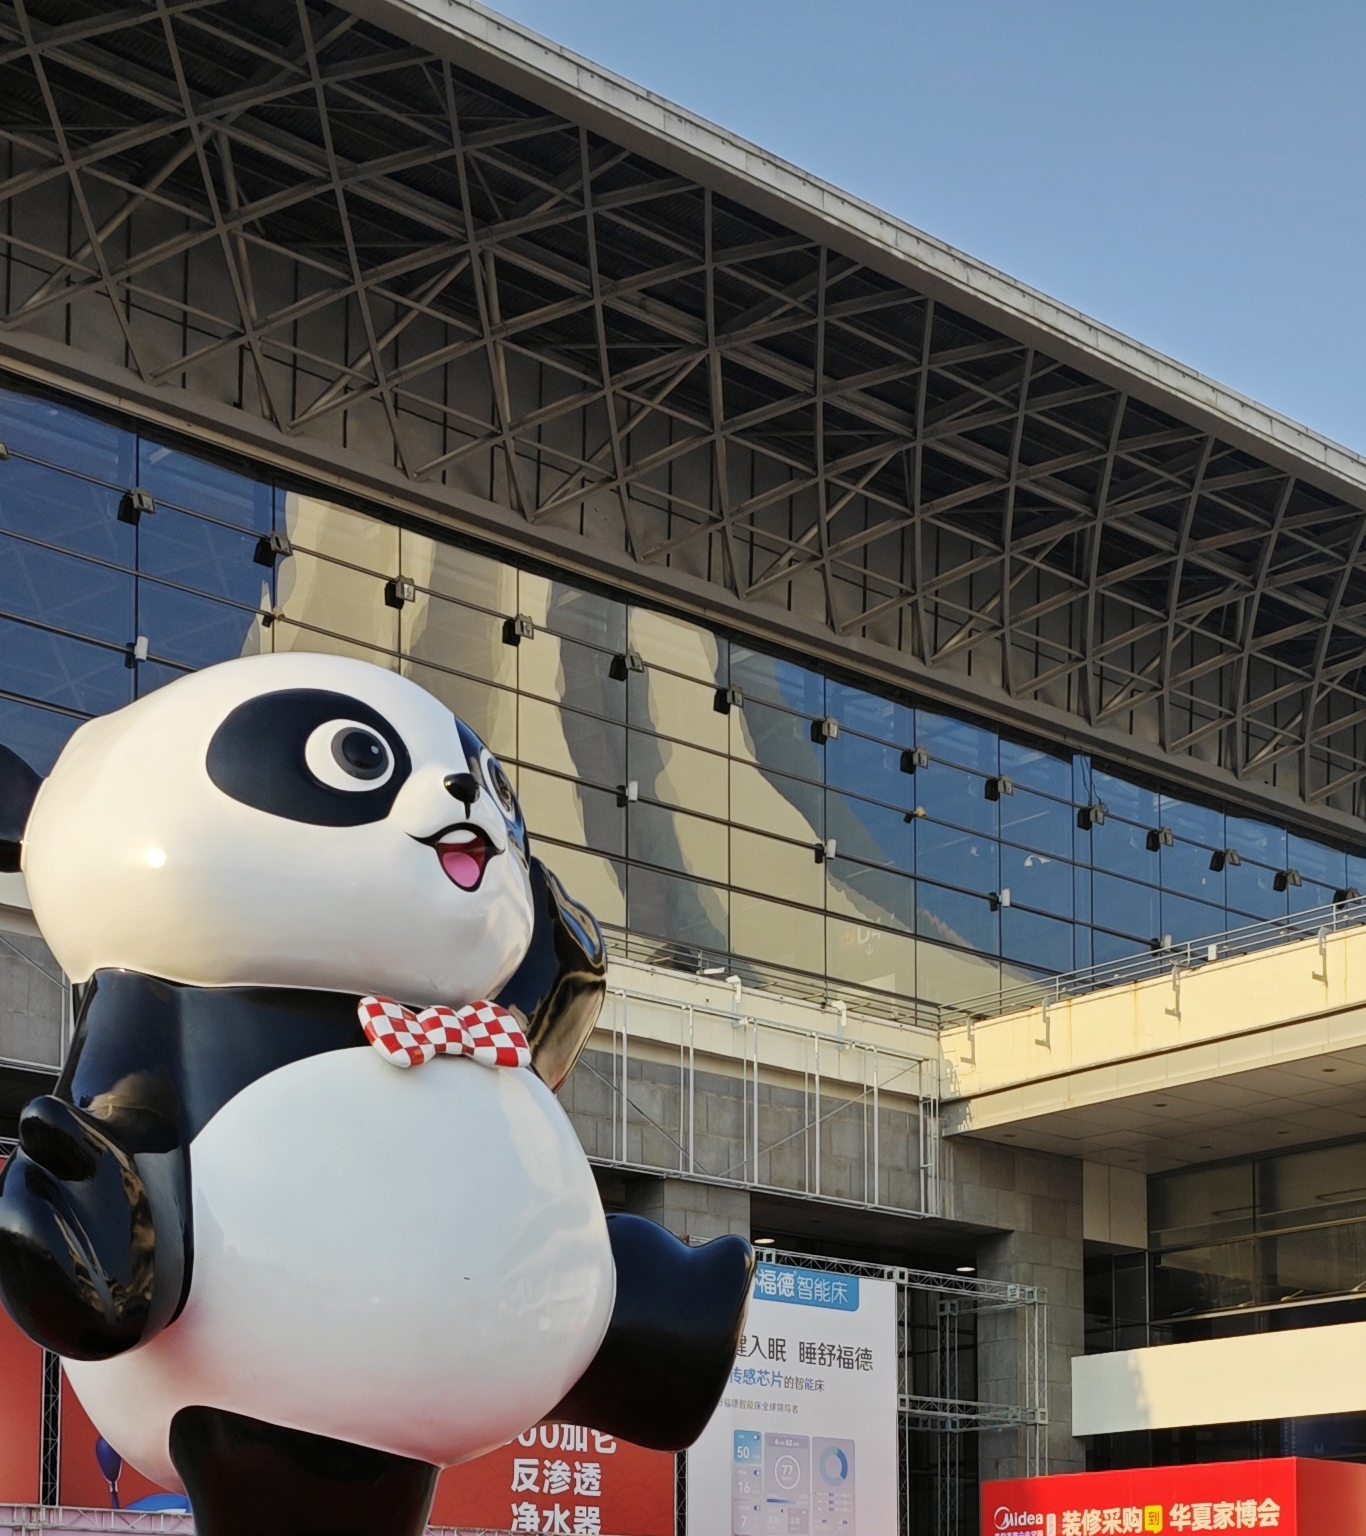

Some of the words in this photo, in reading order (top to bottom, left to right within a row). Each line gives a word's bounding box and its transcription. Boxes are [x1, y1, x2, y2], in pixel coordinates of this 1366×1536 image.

[798, 1341, 874, 1372] 睡舒福德
[510, 1458, 602, 1497] 反渗透
[510, 1501, 602, 1536] 净水器
[993, 1506, 1044, 1531] Midea
[1169, 1498, 1281, 1532] 华夏家博会
